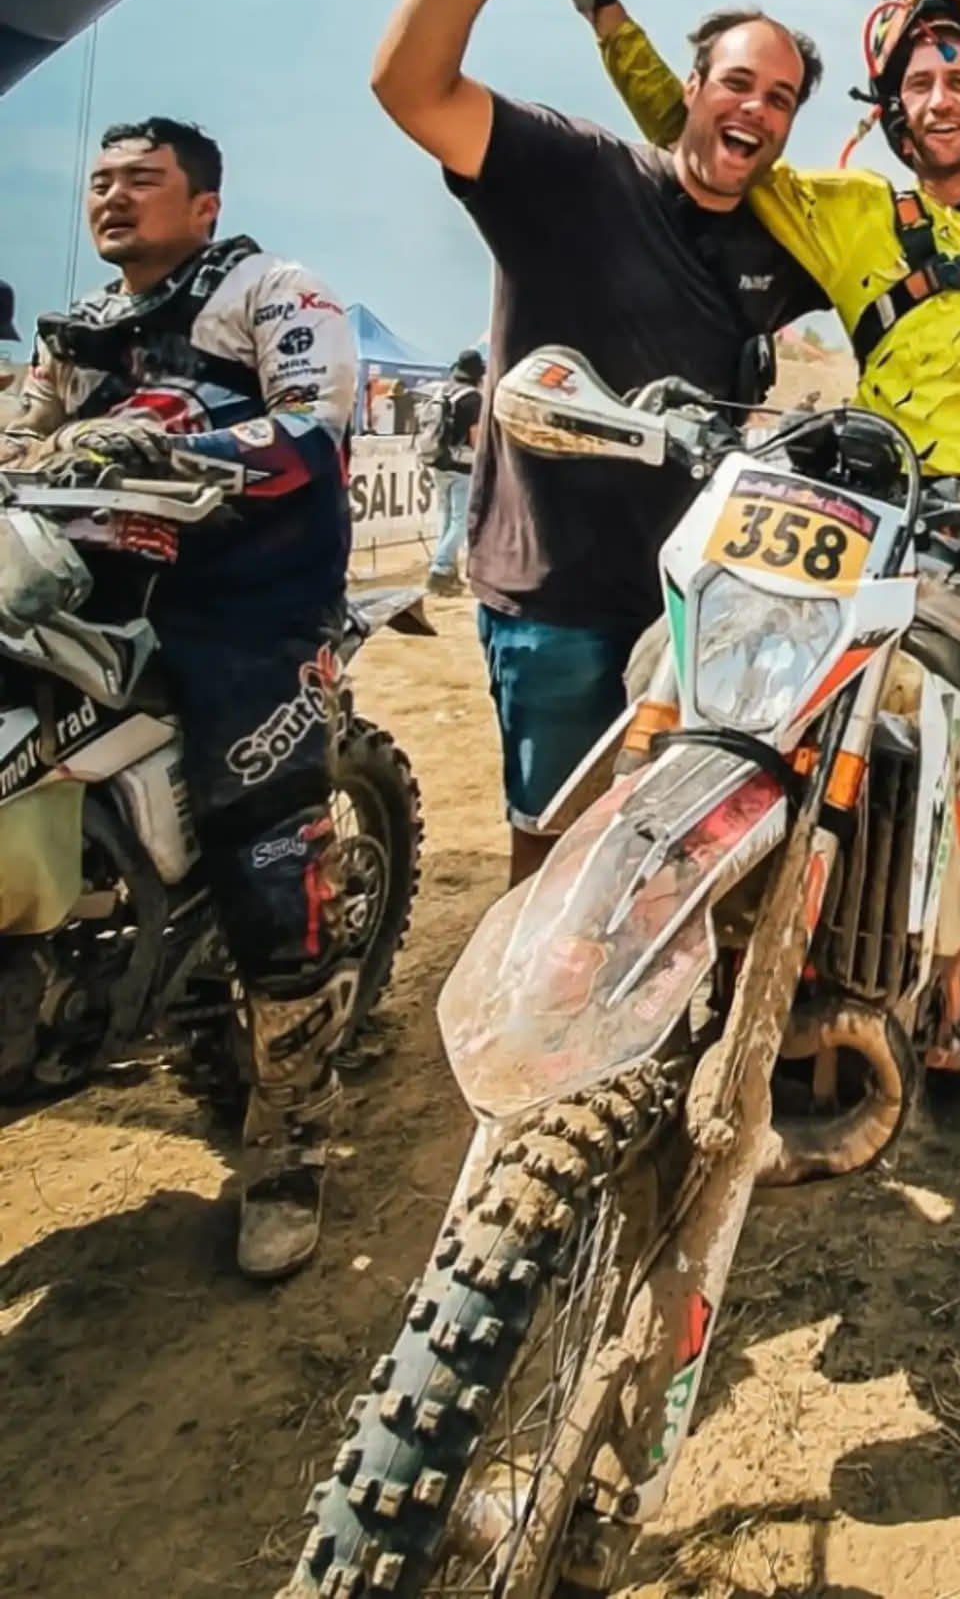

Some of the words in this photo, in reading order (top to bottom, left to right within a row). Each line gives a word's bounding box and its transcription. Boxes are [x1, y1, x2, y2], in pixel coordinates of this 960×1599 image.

[722, 503, 848, 581] 358
[0, 694, 97, 796] motrad
[226, 686, 330, 785] South
